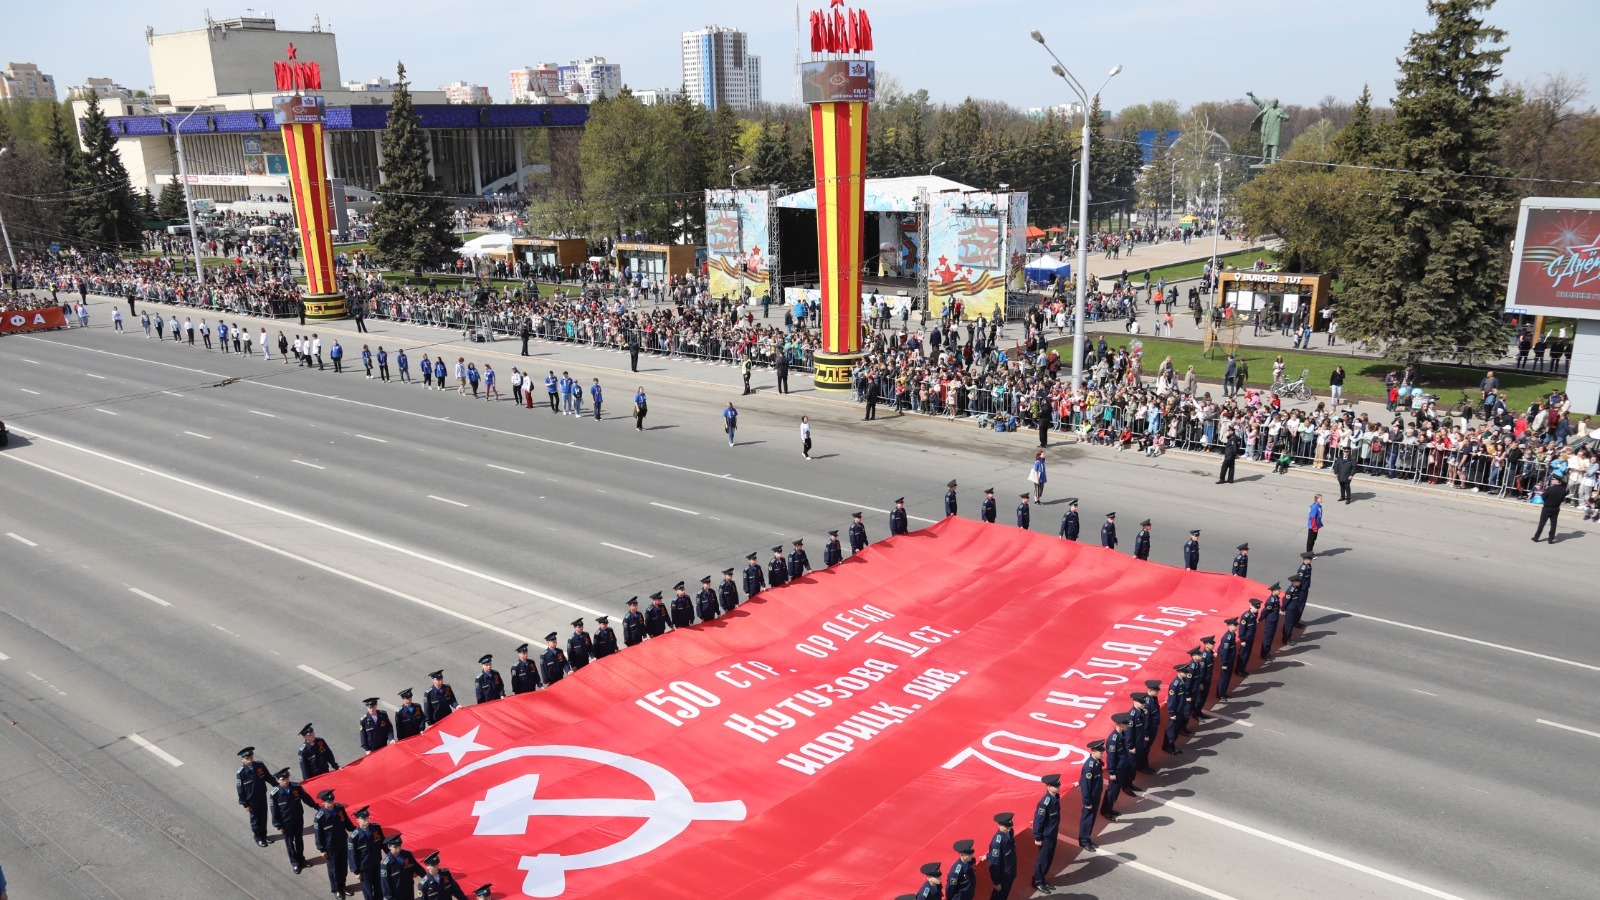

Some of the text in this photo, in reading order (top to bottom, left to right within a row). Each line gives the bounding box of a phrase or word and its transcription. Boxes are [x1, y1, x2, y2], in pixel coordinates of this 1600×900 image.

[823, 366, 853, 382] ЛЕ
[634, 680, 722, 727] 150
[795, 603, 896, 659] ОРДЕНА
[902, 667, 969, 701] ДИВ.
[940, 730, 1089, 783] 79
